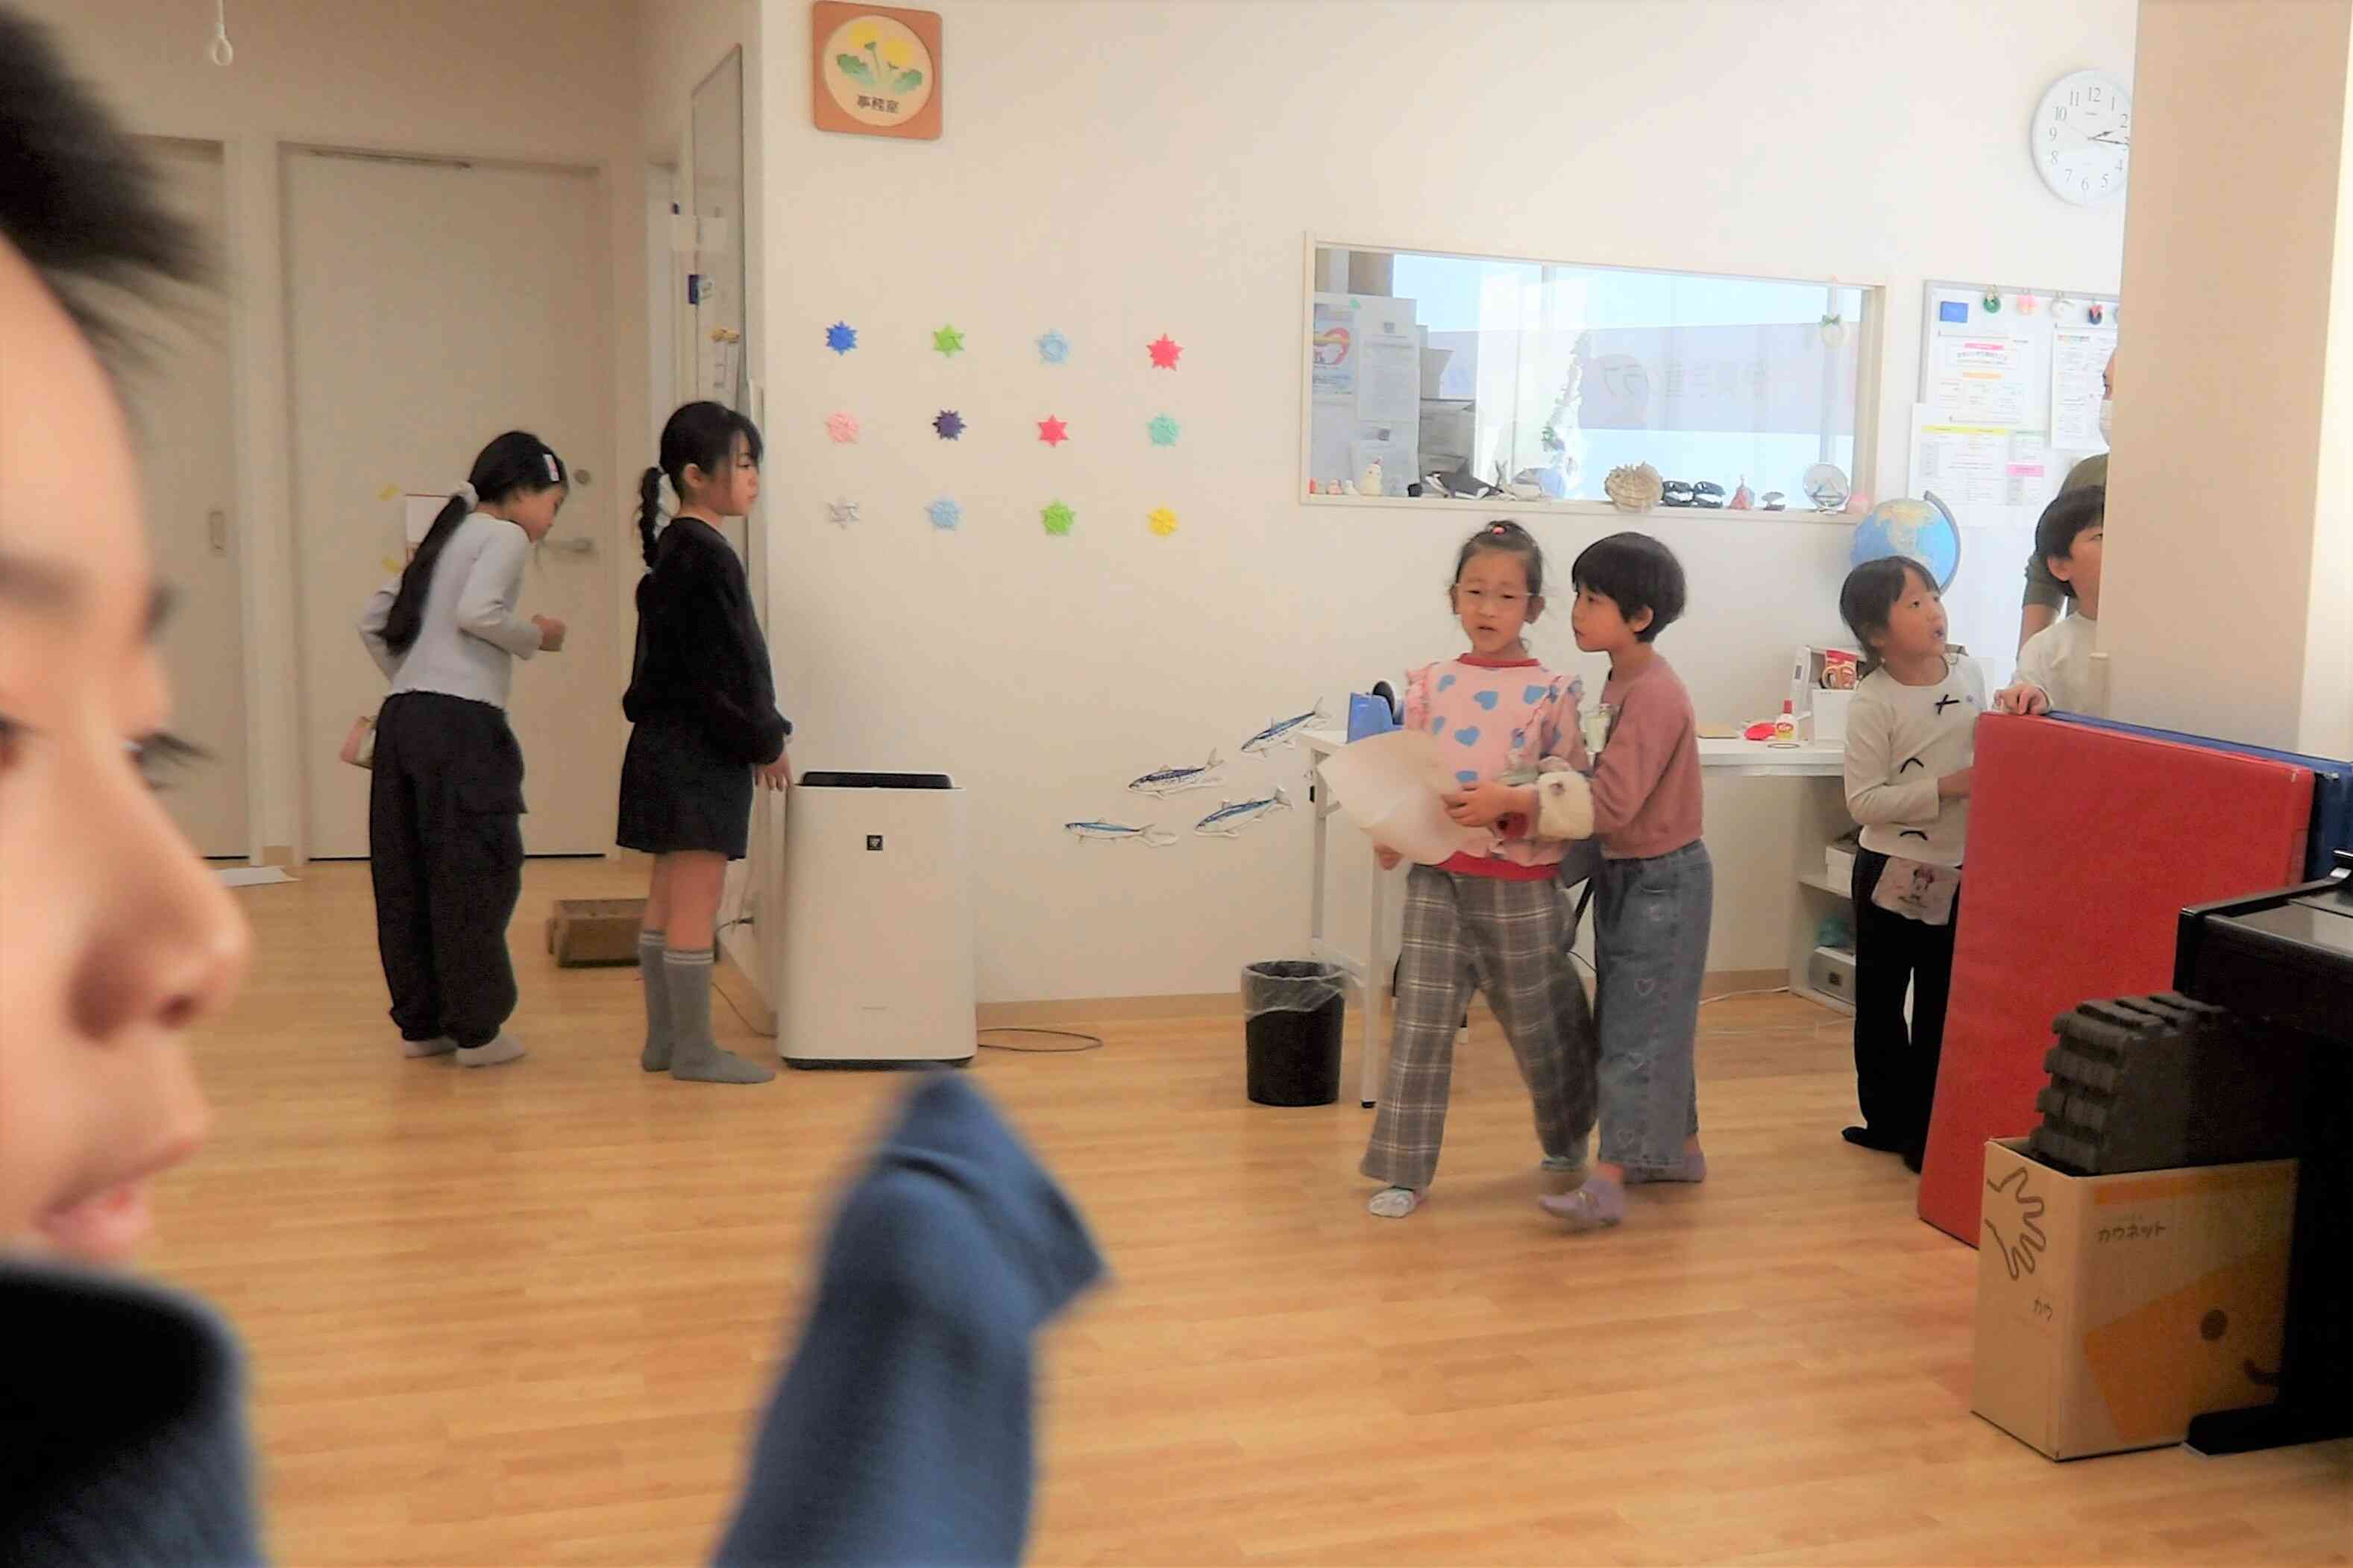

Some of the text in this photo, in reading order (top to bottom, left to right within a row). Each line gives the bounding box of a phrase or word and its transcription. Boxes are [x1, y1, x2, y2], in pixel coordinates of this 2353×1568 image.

[2070, 90, 2080, 107] 11
[2088, 86, 2101, 102] 12
[2054, 107, 2067, 122] 10
[2120, 113, 2129, 128] 2
[2049, 127, 2058, 142] 9
[2051, 150, 2059, 166] 8
[2115, 160, 2123, 172] 4
[2064, 169, 2073, 184] 7
[2101, 173, 2109, 188] 5
[2081, 178, 2090, 191] 6
[2099, 1221, 2166, 1243] カウネット
